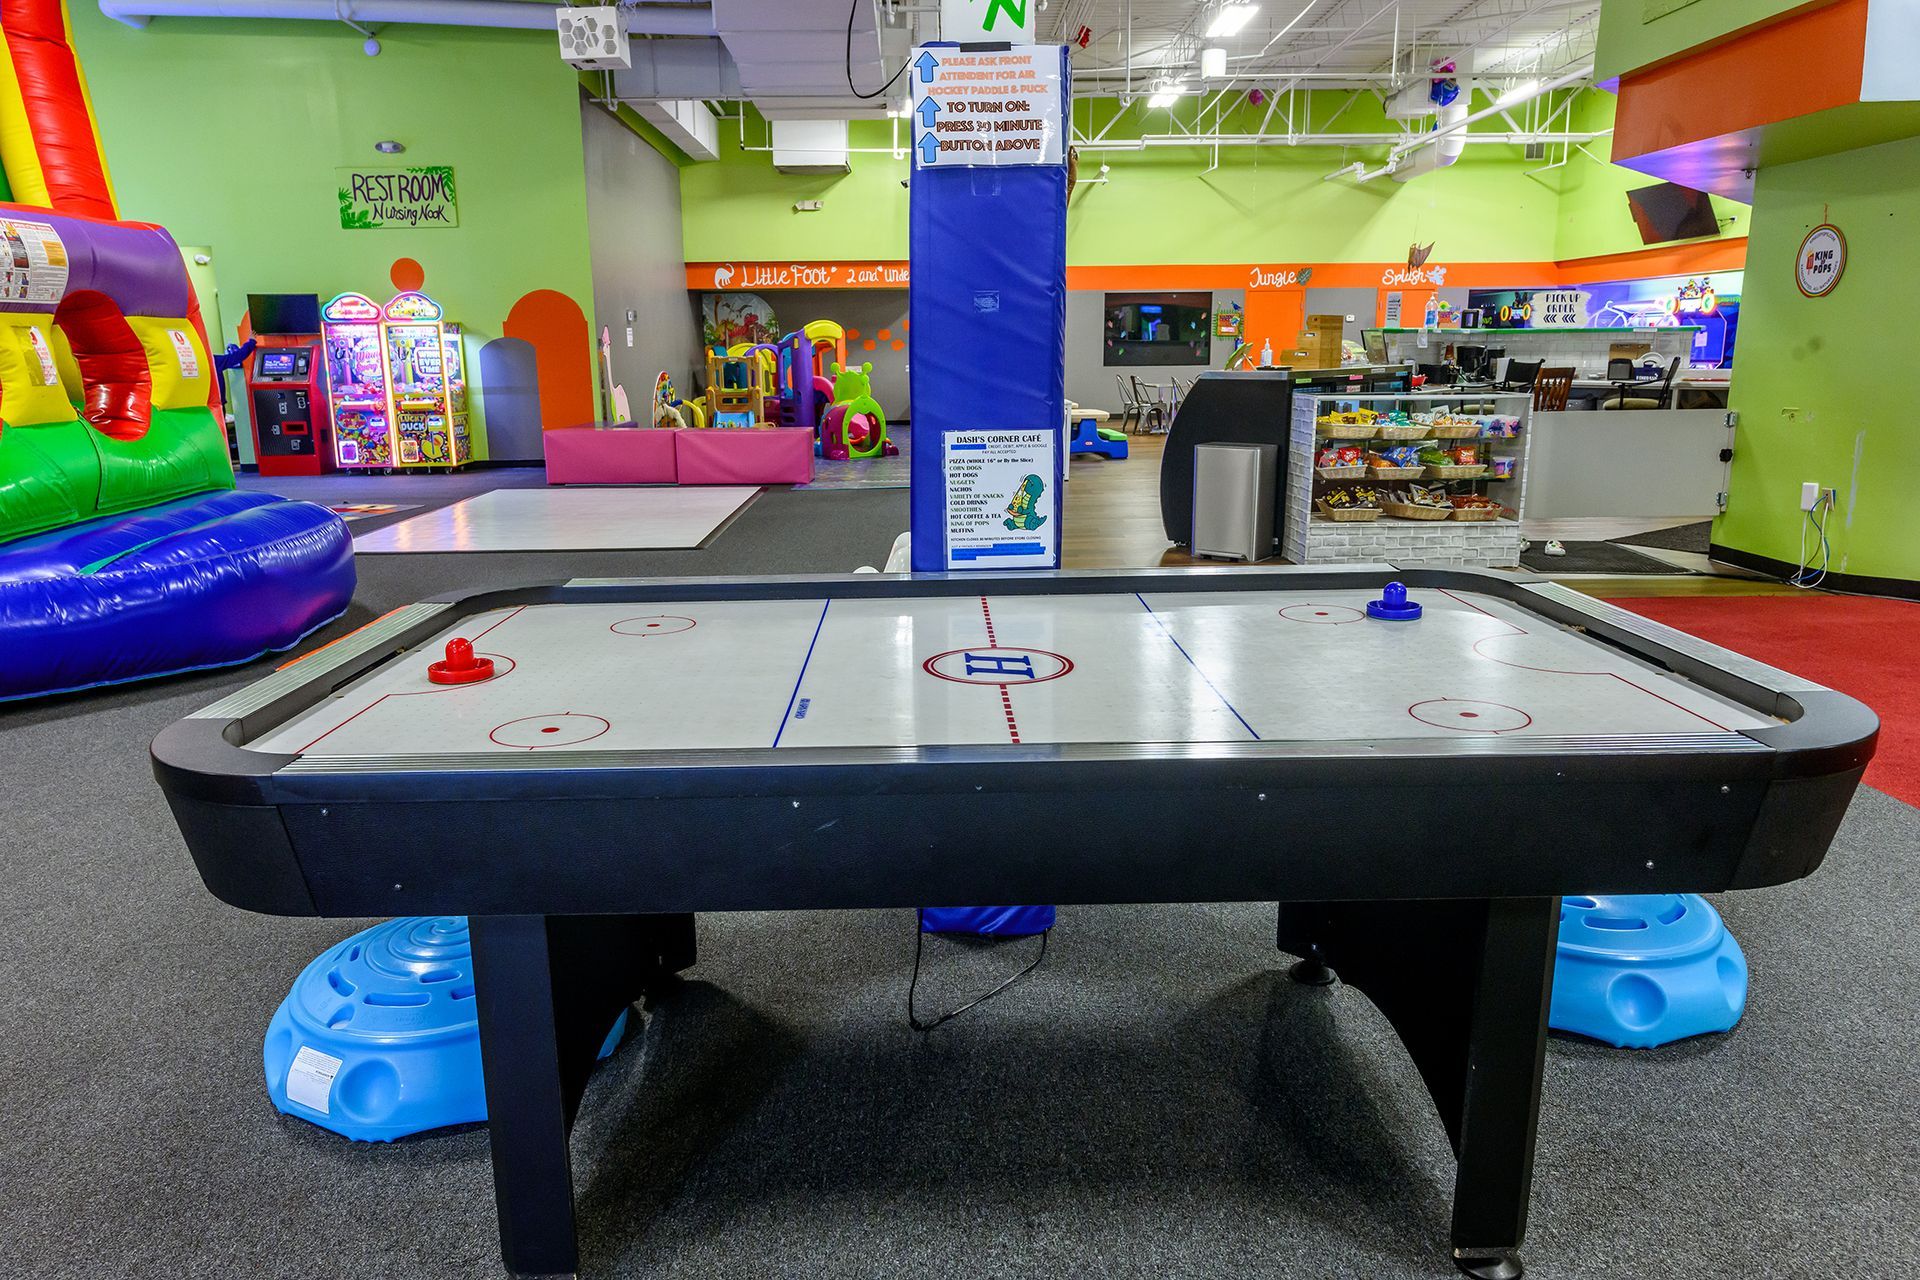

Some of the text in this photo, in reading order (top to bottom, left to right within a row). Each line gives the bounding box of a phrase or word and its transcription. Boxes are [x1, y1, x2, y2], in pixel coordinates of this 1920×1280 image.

[941, 55, 1032, 67] PLEASE ASK FRONT
[939, 70, 1035, 81] ATTENDENT FOR AIR
[928, 84, 1048, 96] HOCKEY PADDLE & PUCK
[947, 101, 1030, 113] TO TURN ON:
[936, 121, 974, 132] PRESS
[994, 119, 1043, 131] MINUTE
[941, 139, 1040, 151] BUTTON ABOVE
[372, 203, 450, 226] Nursing Nook
[1815, 250, 1834, 261] KING
[1813, 264, 1832, 274] POPS
[790, 265, 830, 286] Foot
[847, 269, 857, 284] 2
[858, 268, 878, 283] and
[1250, 267, 1297, 288] Jungle
[1546, 294, 1580, 303] PICK UP
[1547, 304, 1575, 313] ORDER
[401, 422, 425, 431] DUCK
[956, 434, 1041, 444] DASH'S CORNER CAFÉ
[964, 652, 1036, 679] H
